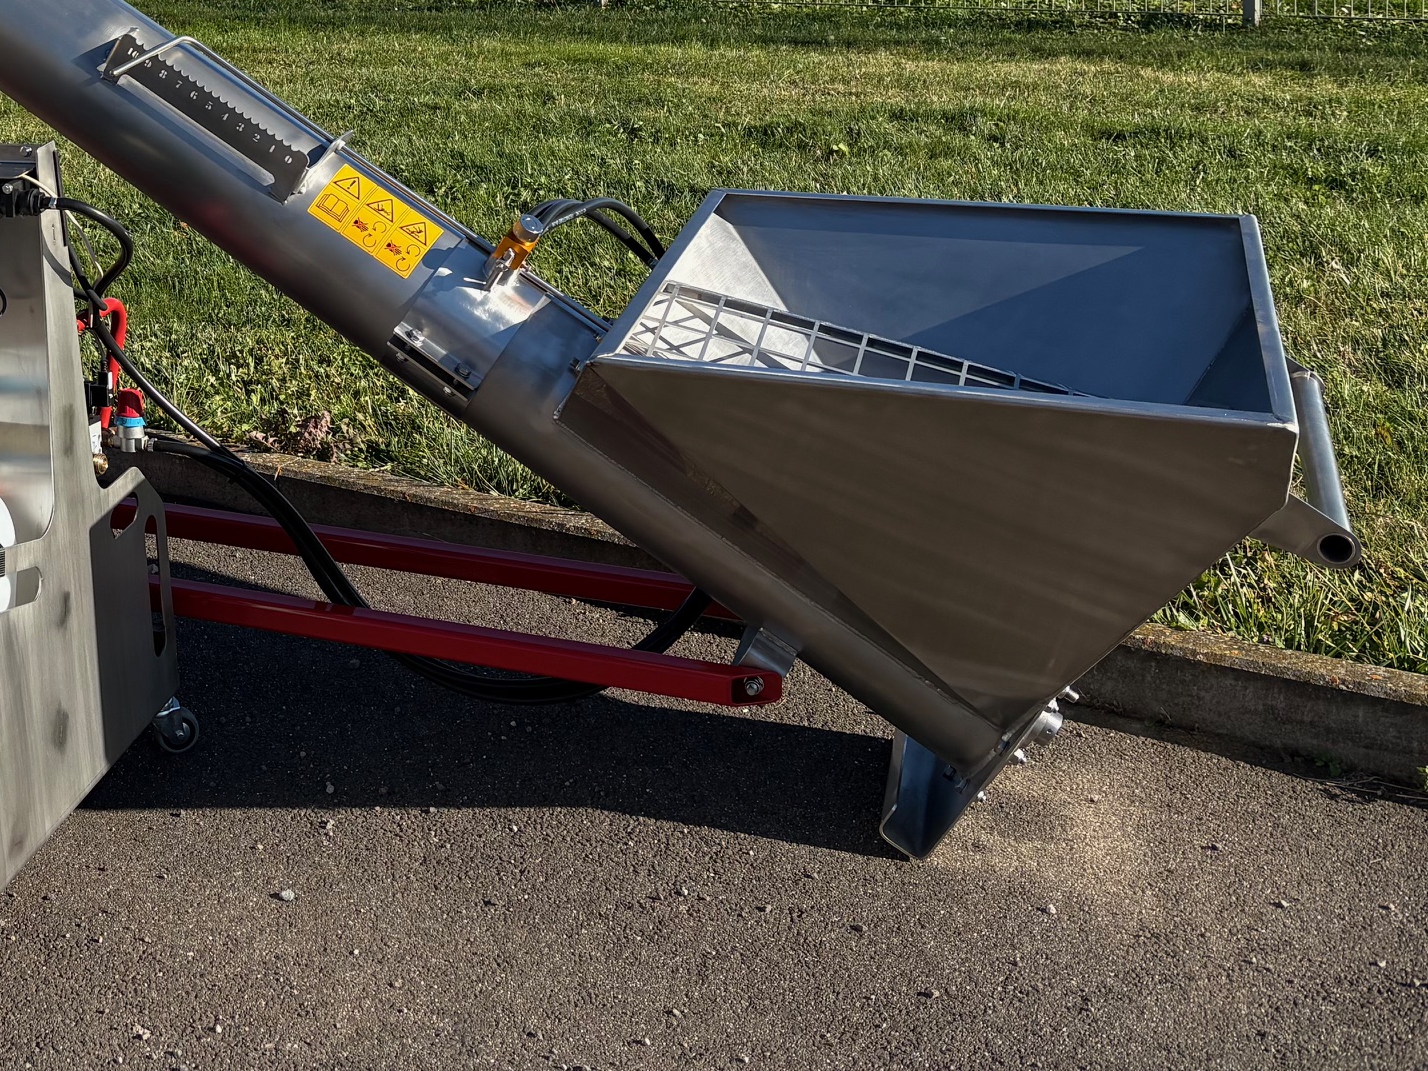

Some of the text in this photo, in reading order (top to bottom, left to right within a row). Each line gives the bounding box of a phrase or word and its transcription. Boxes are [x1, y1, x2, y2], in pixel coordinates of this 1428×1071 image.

[127, 47, 293, 164] 10 9 8 7 6 5 4 3 2 1 0
